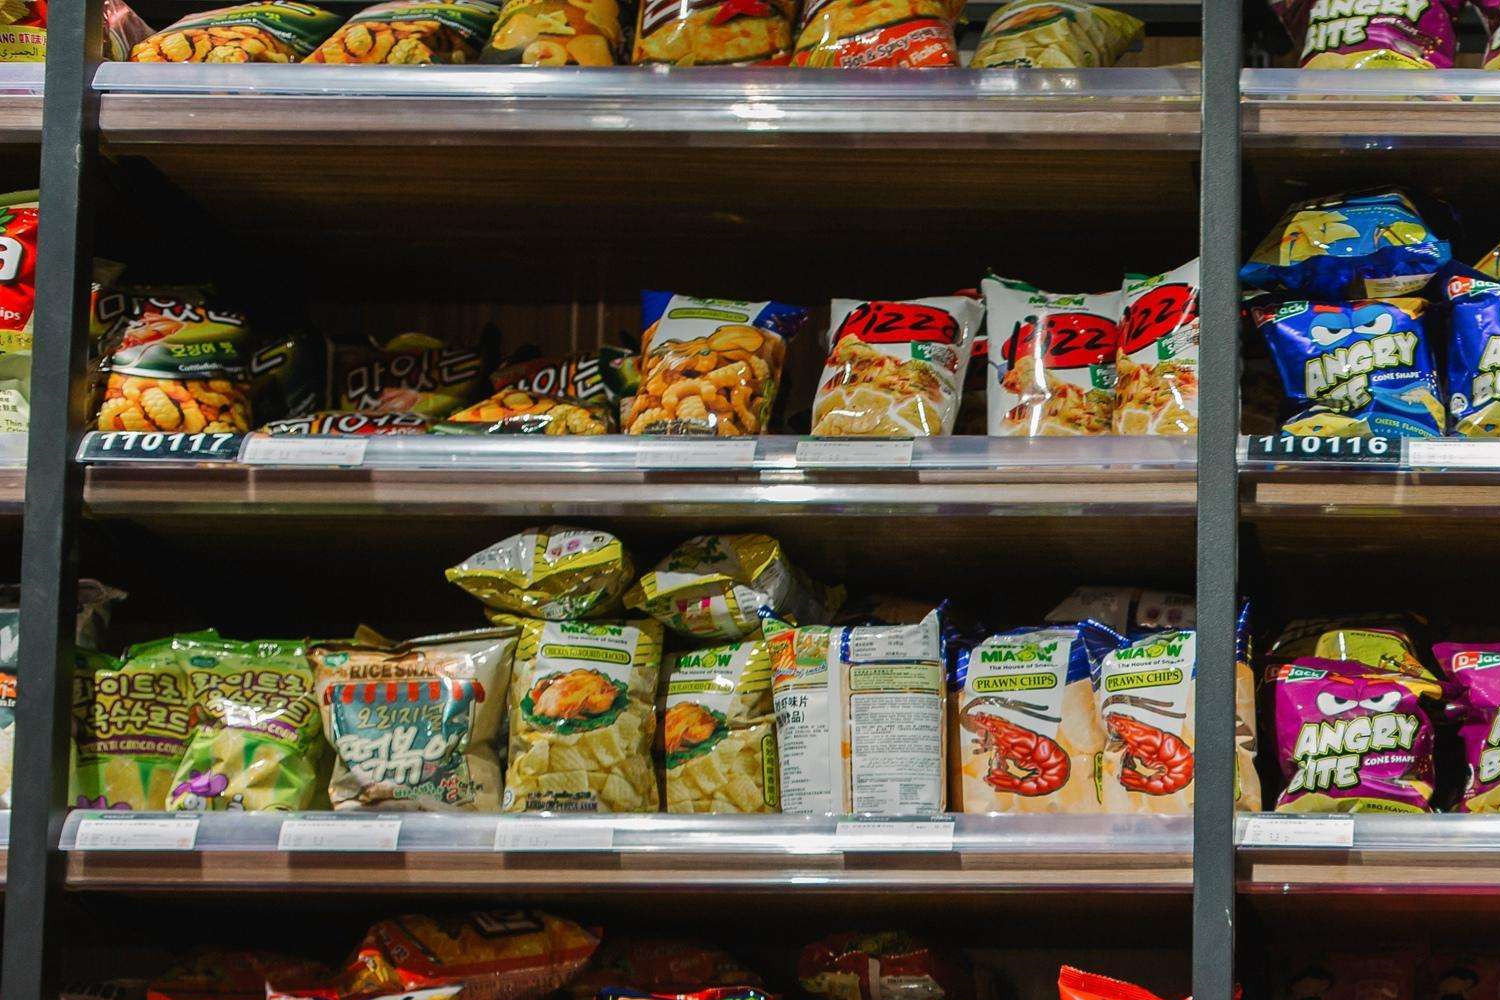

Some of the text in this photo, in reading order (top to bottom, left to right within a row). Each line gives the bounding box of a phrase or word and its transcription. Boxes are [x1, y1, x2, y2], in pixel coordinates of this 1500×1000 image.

[828, 301, 961, 357] Pizza
[1305, 331, 1418, 397] ANGRY
[101, 432, 234, 451] 110117
[1259, 437, 1388, 453] 110116
[350, 664, 389, 679] RICE
[1107, 671, 1180, 688] PRAWN CHIPS
[977, 675, 1054, 689] PRAWN CHIPS
[1294, 713, 1419, 759] ANGRY
[1364, 756, 1389, 766] CONE
[1288, 755, 1360, 793] BITE
